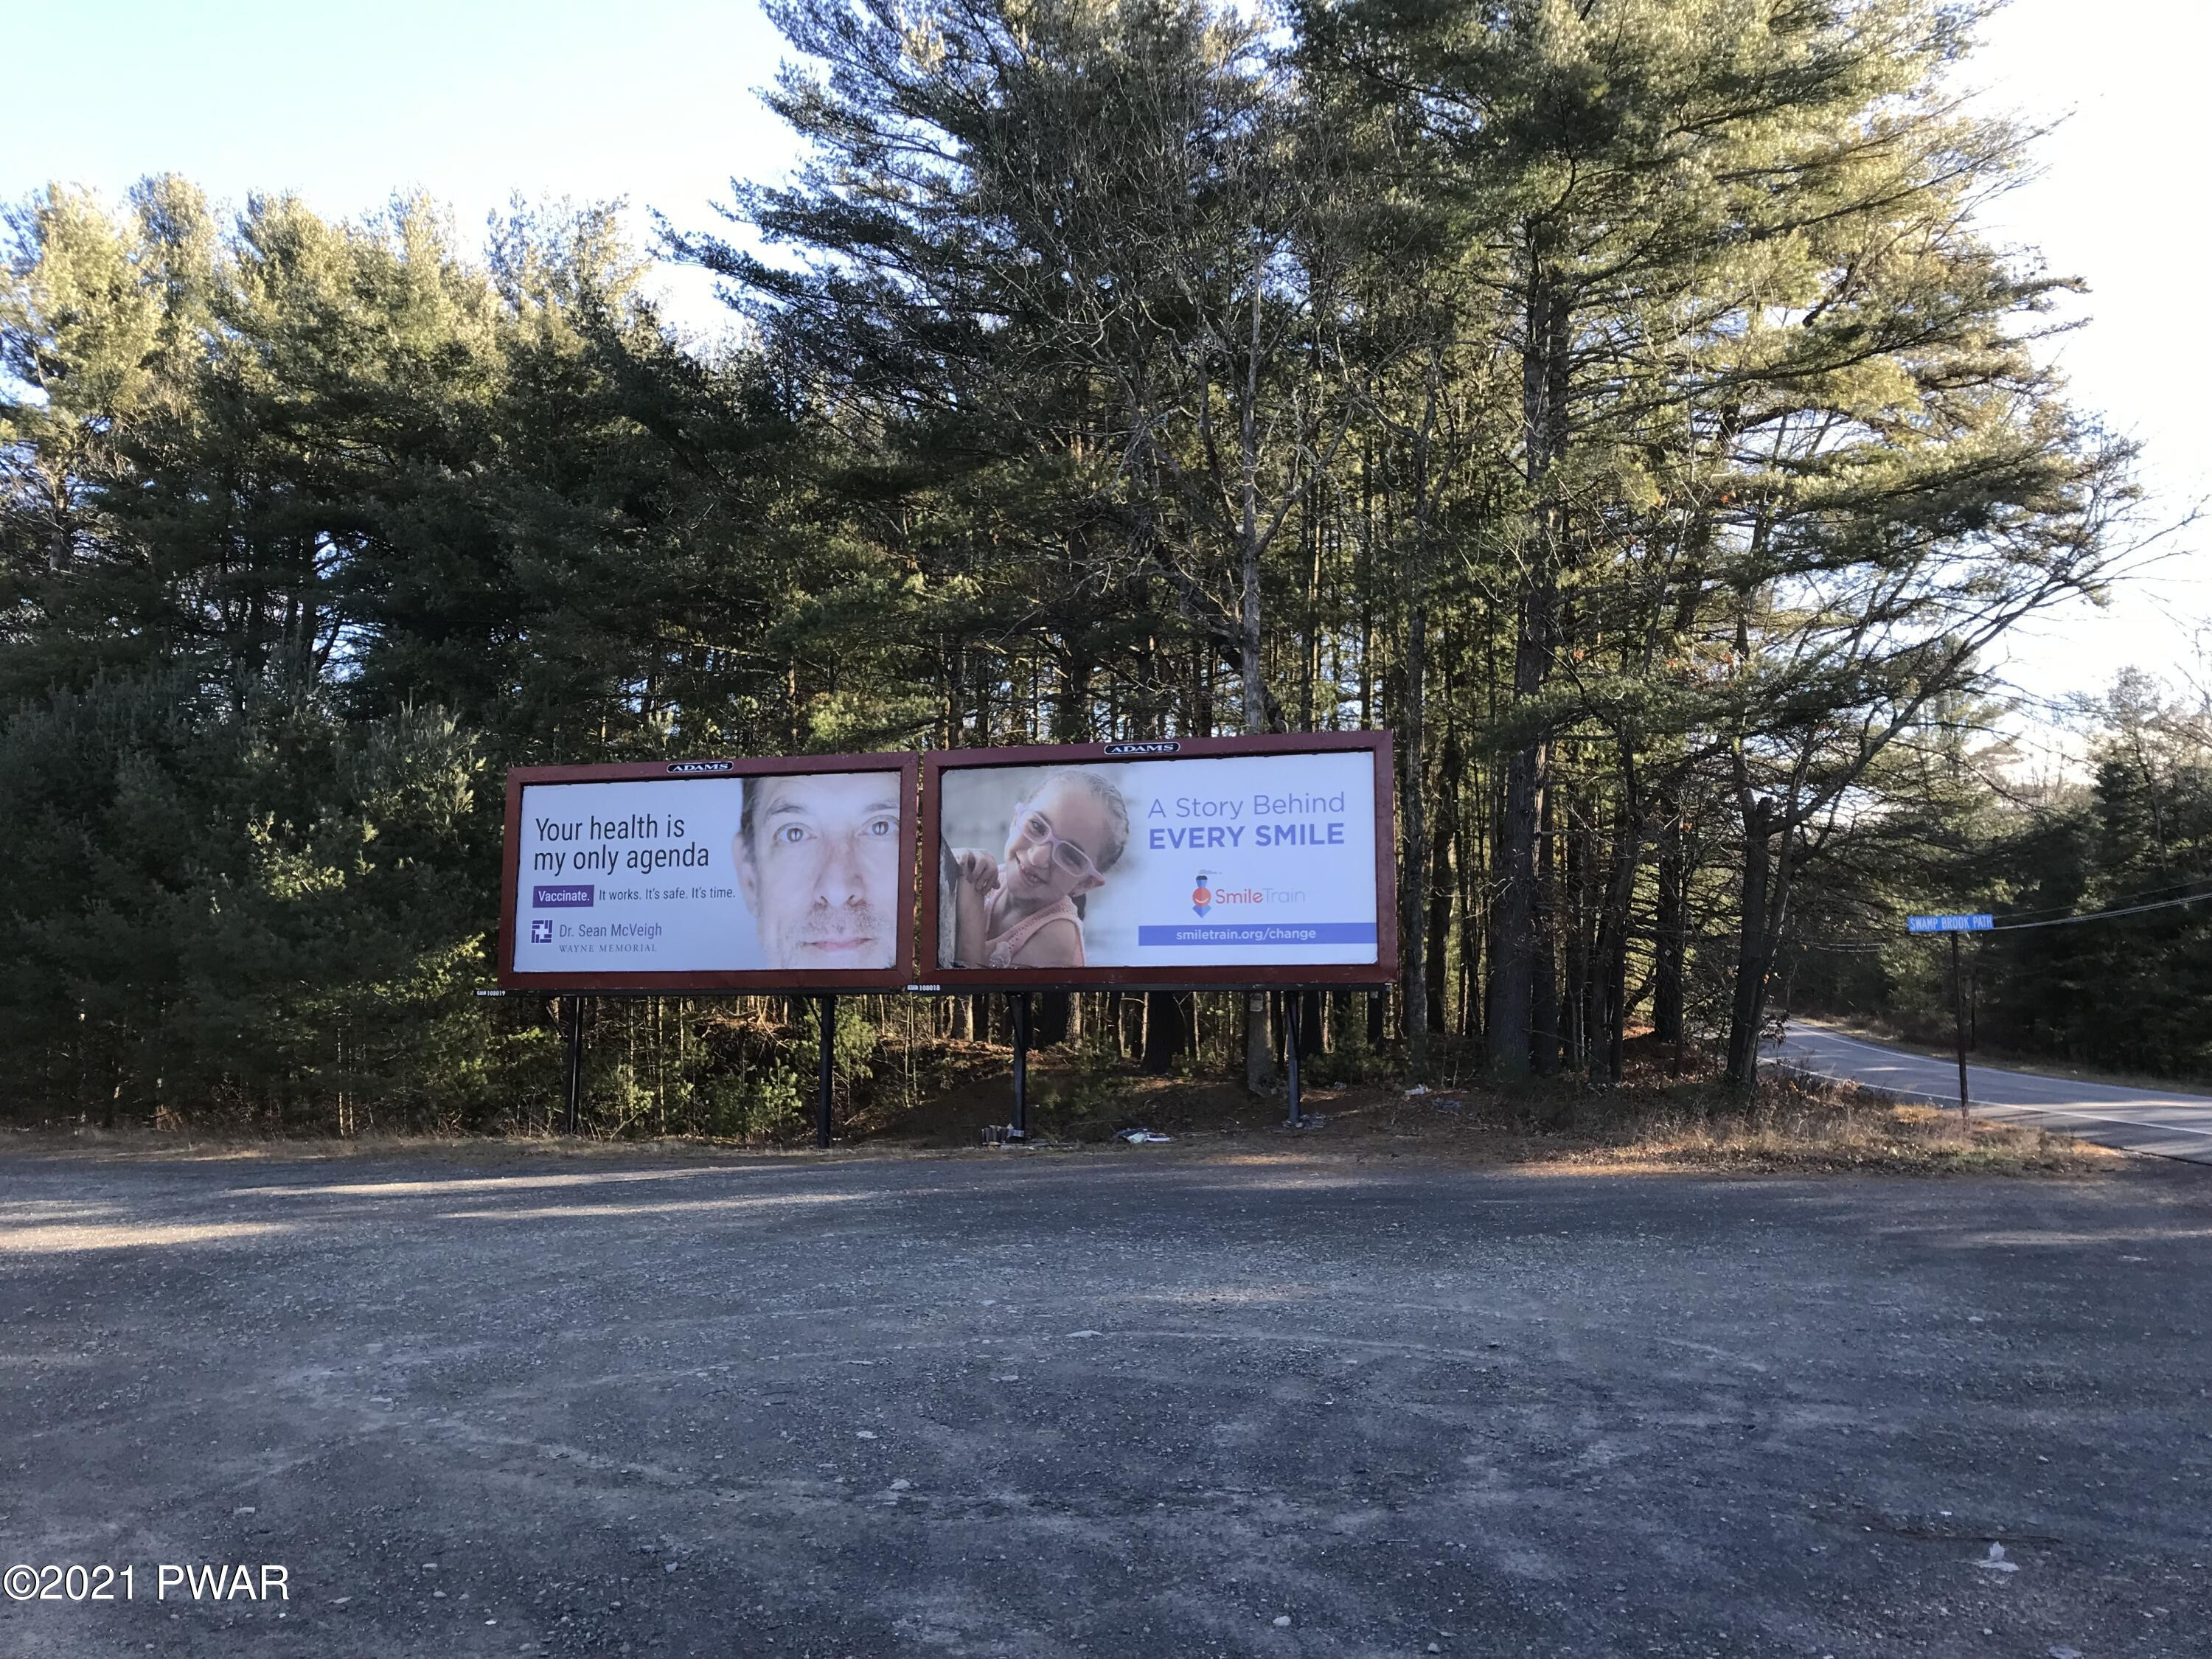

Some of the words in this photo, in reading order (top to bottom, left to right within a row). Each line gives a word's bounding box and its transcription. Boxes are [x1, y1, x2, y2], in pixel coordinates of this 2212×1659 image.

[1110, 744, 1174, 752] ADAMS
[672, 763, 728, 771] ADAMS
[1148, 799, 1166, 818] A
[1175, 797, 1244, 820] Story
[1253, 791, 1345, 815] Behind
[535, 818, 582, 841] Your
[590, 813, 658, 840] health
[667, 814, 685, 838] is
[1150, 826, 1245, 849] EVERY
[1255, 823, 1345, 846] SMILE
[534, 852, 566, 877] my
[573, 844, 619, 875] only
[627, 841, 709, 874] agenda
[538, 889, 590, 902] Vaccinate.
[599, 889, 607, 900] It
[609, 889, 641, 900] works.
[645, 888, 660, 900] It's
[663, 887, 687, 899] safe.
[692, 887, 706, 899] It's
[709, 886, 735, 898] time.
[1910, 917, 1938, 930] SWAMP
[1941, 916, 1970, 929] BROOK
[1972, 914, 1993, 928] PATH
[559, 924, 574, 937] Dr.
[578, 924, 607, 937] Sean
[611, 923, 662, 939] McVeigh
[1176, 928, 1316, 941] smiletrain.org/change
[559, 944, 594, 953] WAYNE
[599, 943, 658, 952] MEMORIAL
